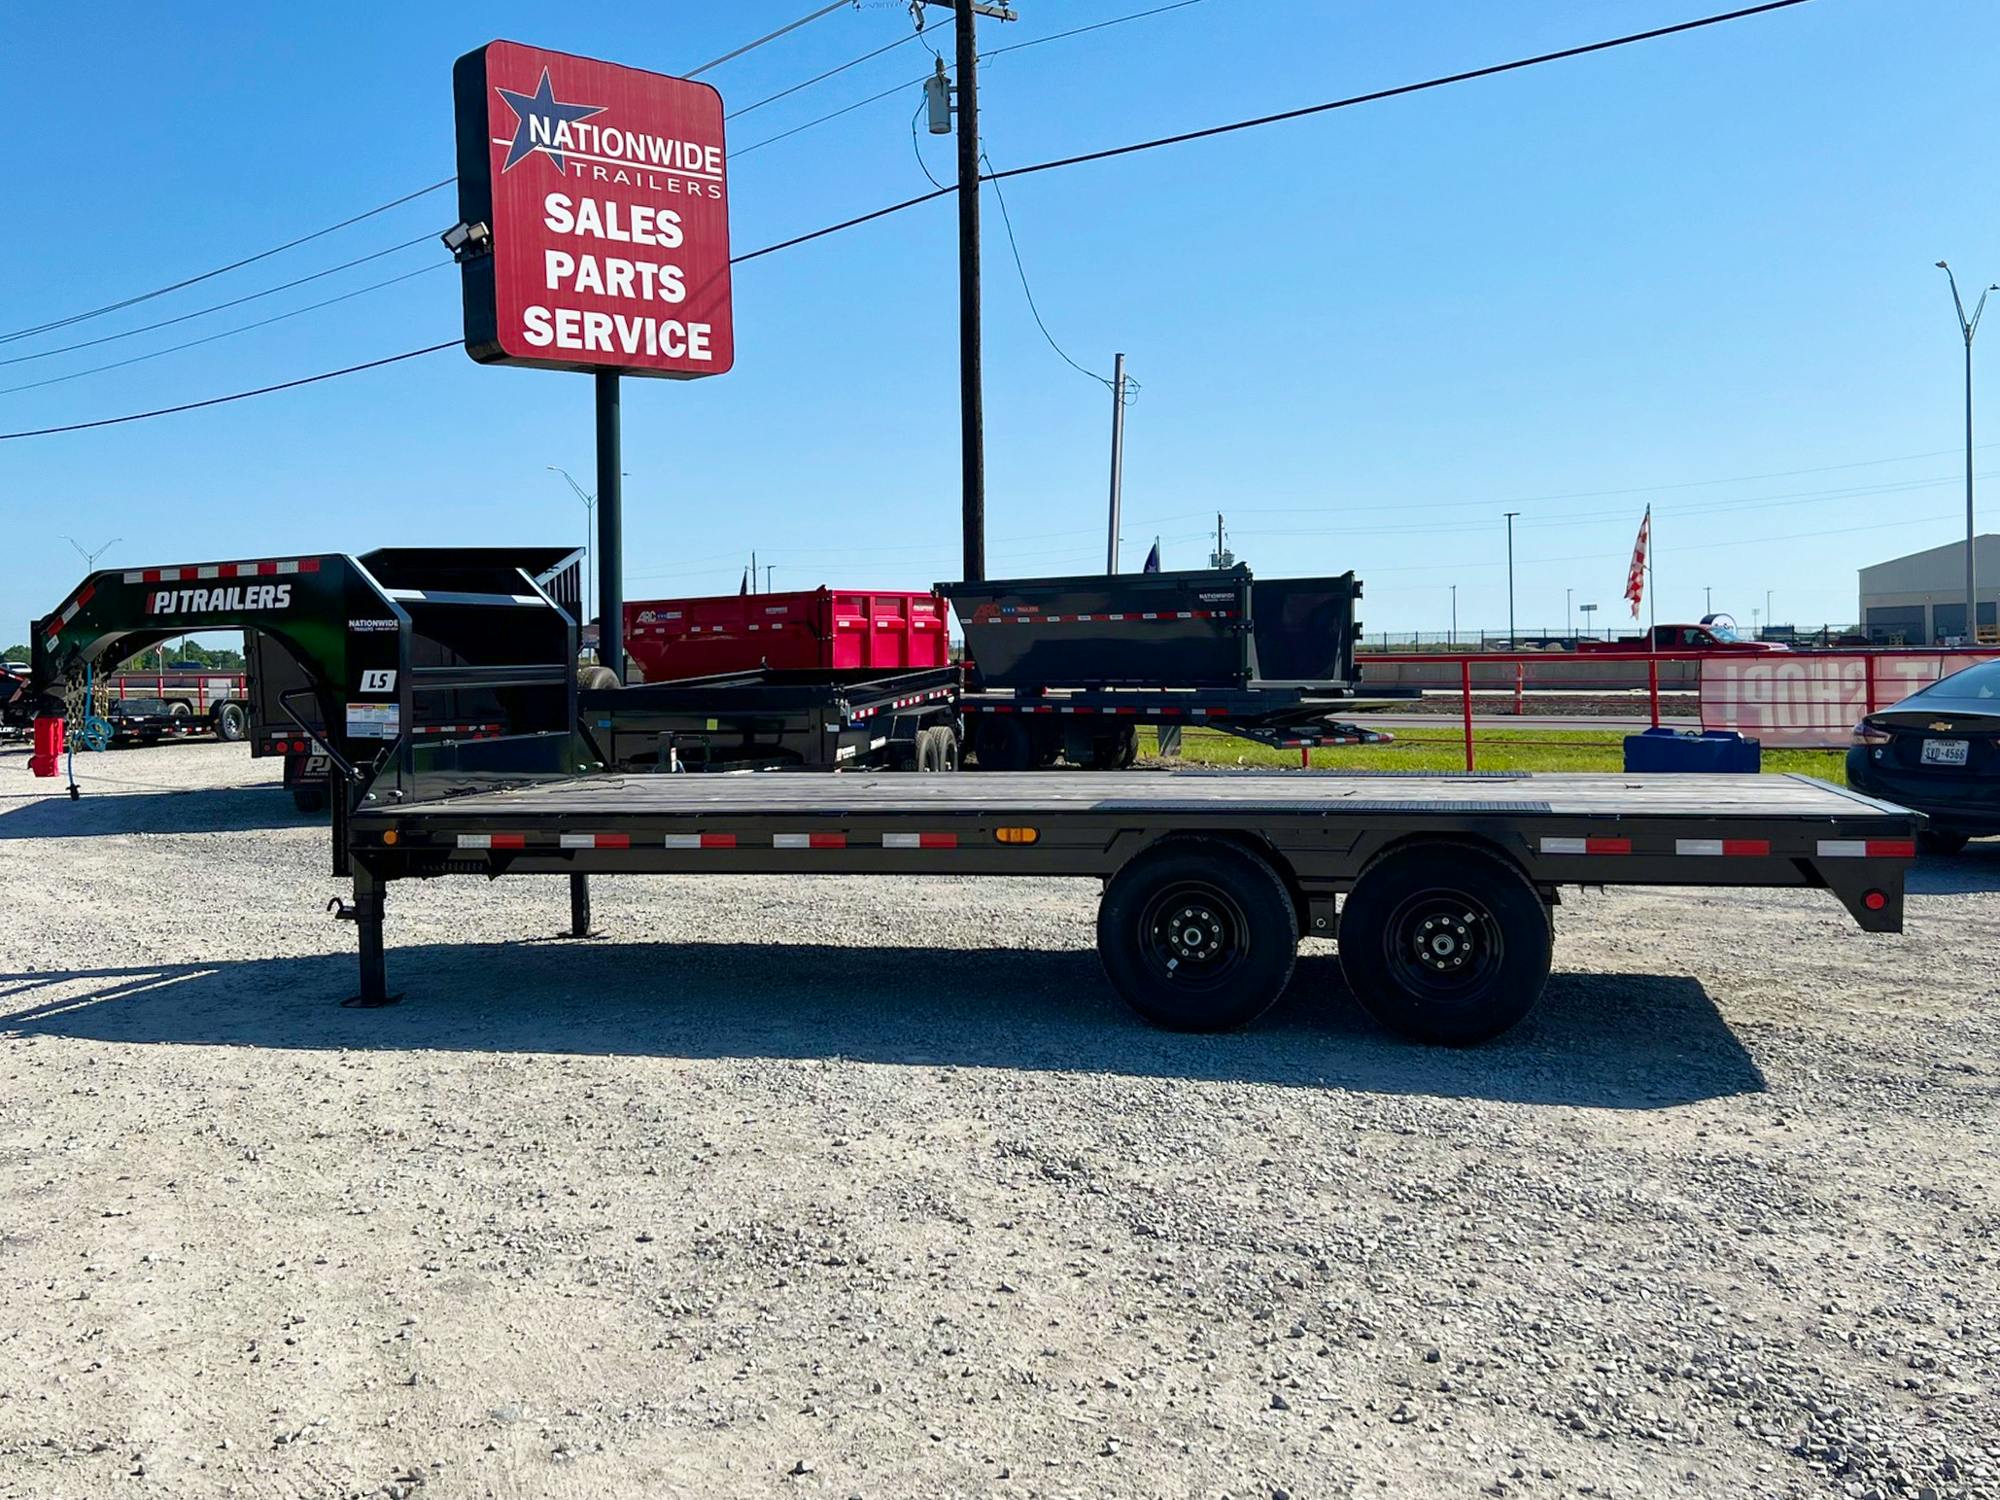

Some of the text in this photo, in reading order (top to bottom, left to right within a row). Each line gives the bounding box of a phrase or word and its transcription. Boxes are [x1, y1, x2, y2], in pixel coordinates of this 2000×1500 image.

[528, 113, 722, 175] NATIONWIDE
[570, 161, 722, 199] TRAILERS
[544, 192, 684, 249] SALES
[545, 249, 687, 303] PARTS
[522, 305, 712, 361] SERVICE
[348, 619, 399, 627] NATIONWIDE
[368, 673, 388, 689] LS
